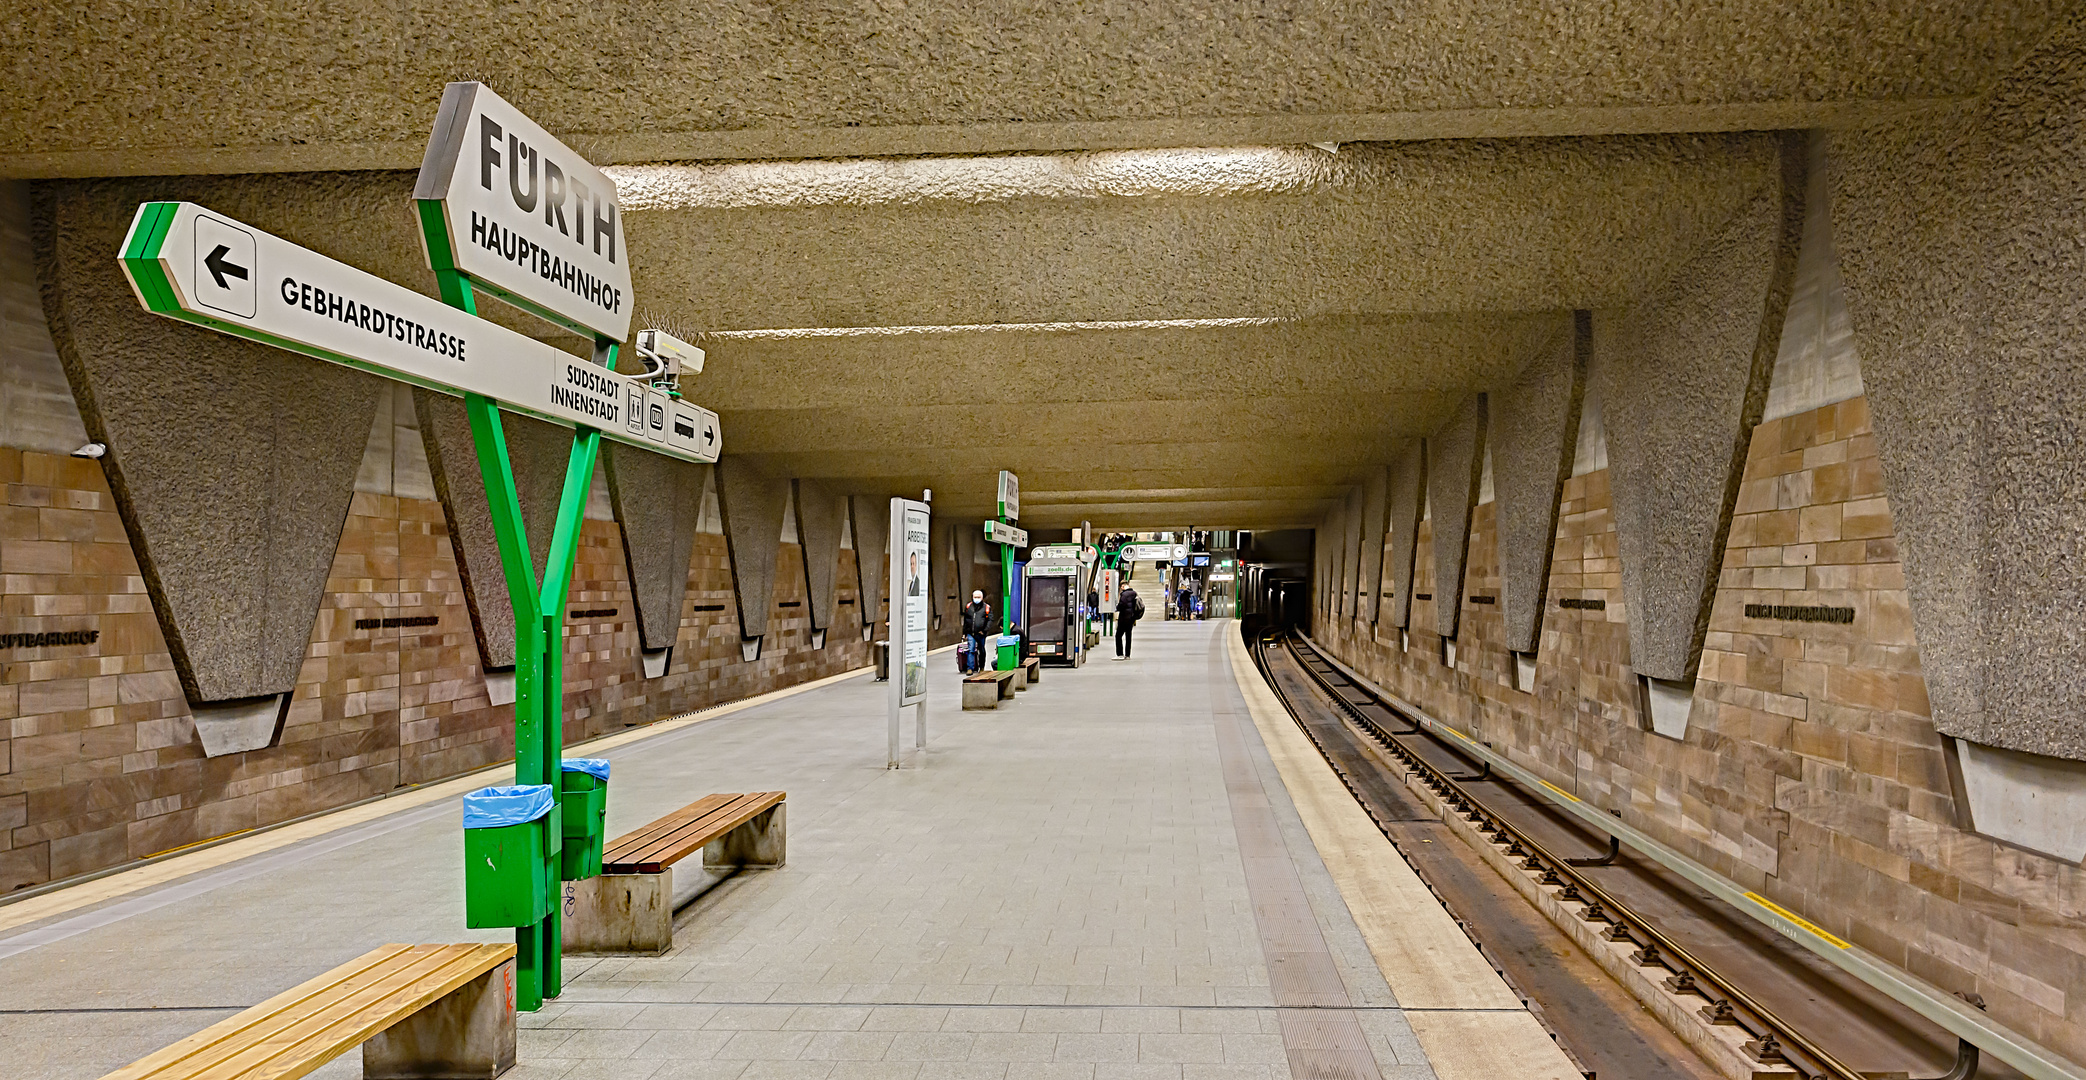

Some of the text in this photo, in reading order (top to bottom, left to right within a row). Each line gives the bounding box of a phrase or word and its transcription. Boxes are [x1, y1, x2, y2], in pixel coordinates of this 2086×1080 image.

[480, 113, 616, 265] FÜRTH
[471, 210, 621, 315] HAUPTBAHNHOF
[281, 277, 466, 362] GEBHARDTSTRASSE
[551, 384, 619, 423] INNENSTADT
[567, 364, 619, 400] SÜDSTADT
[1773, 605, 1855, 623] HAUPTBAHNHOF
